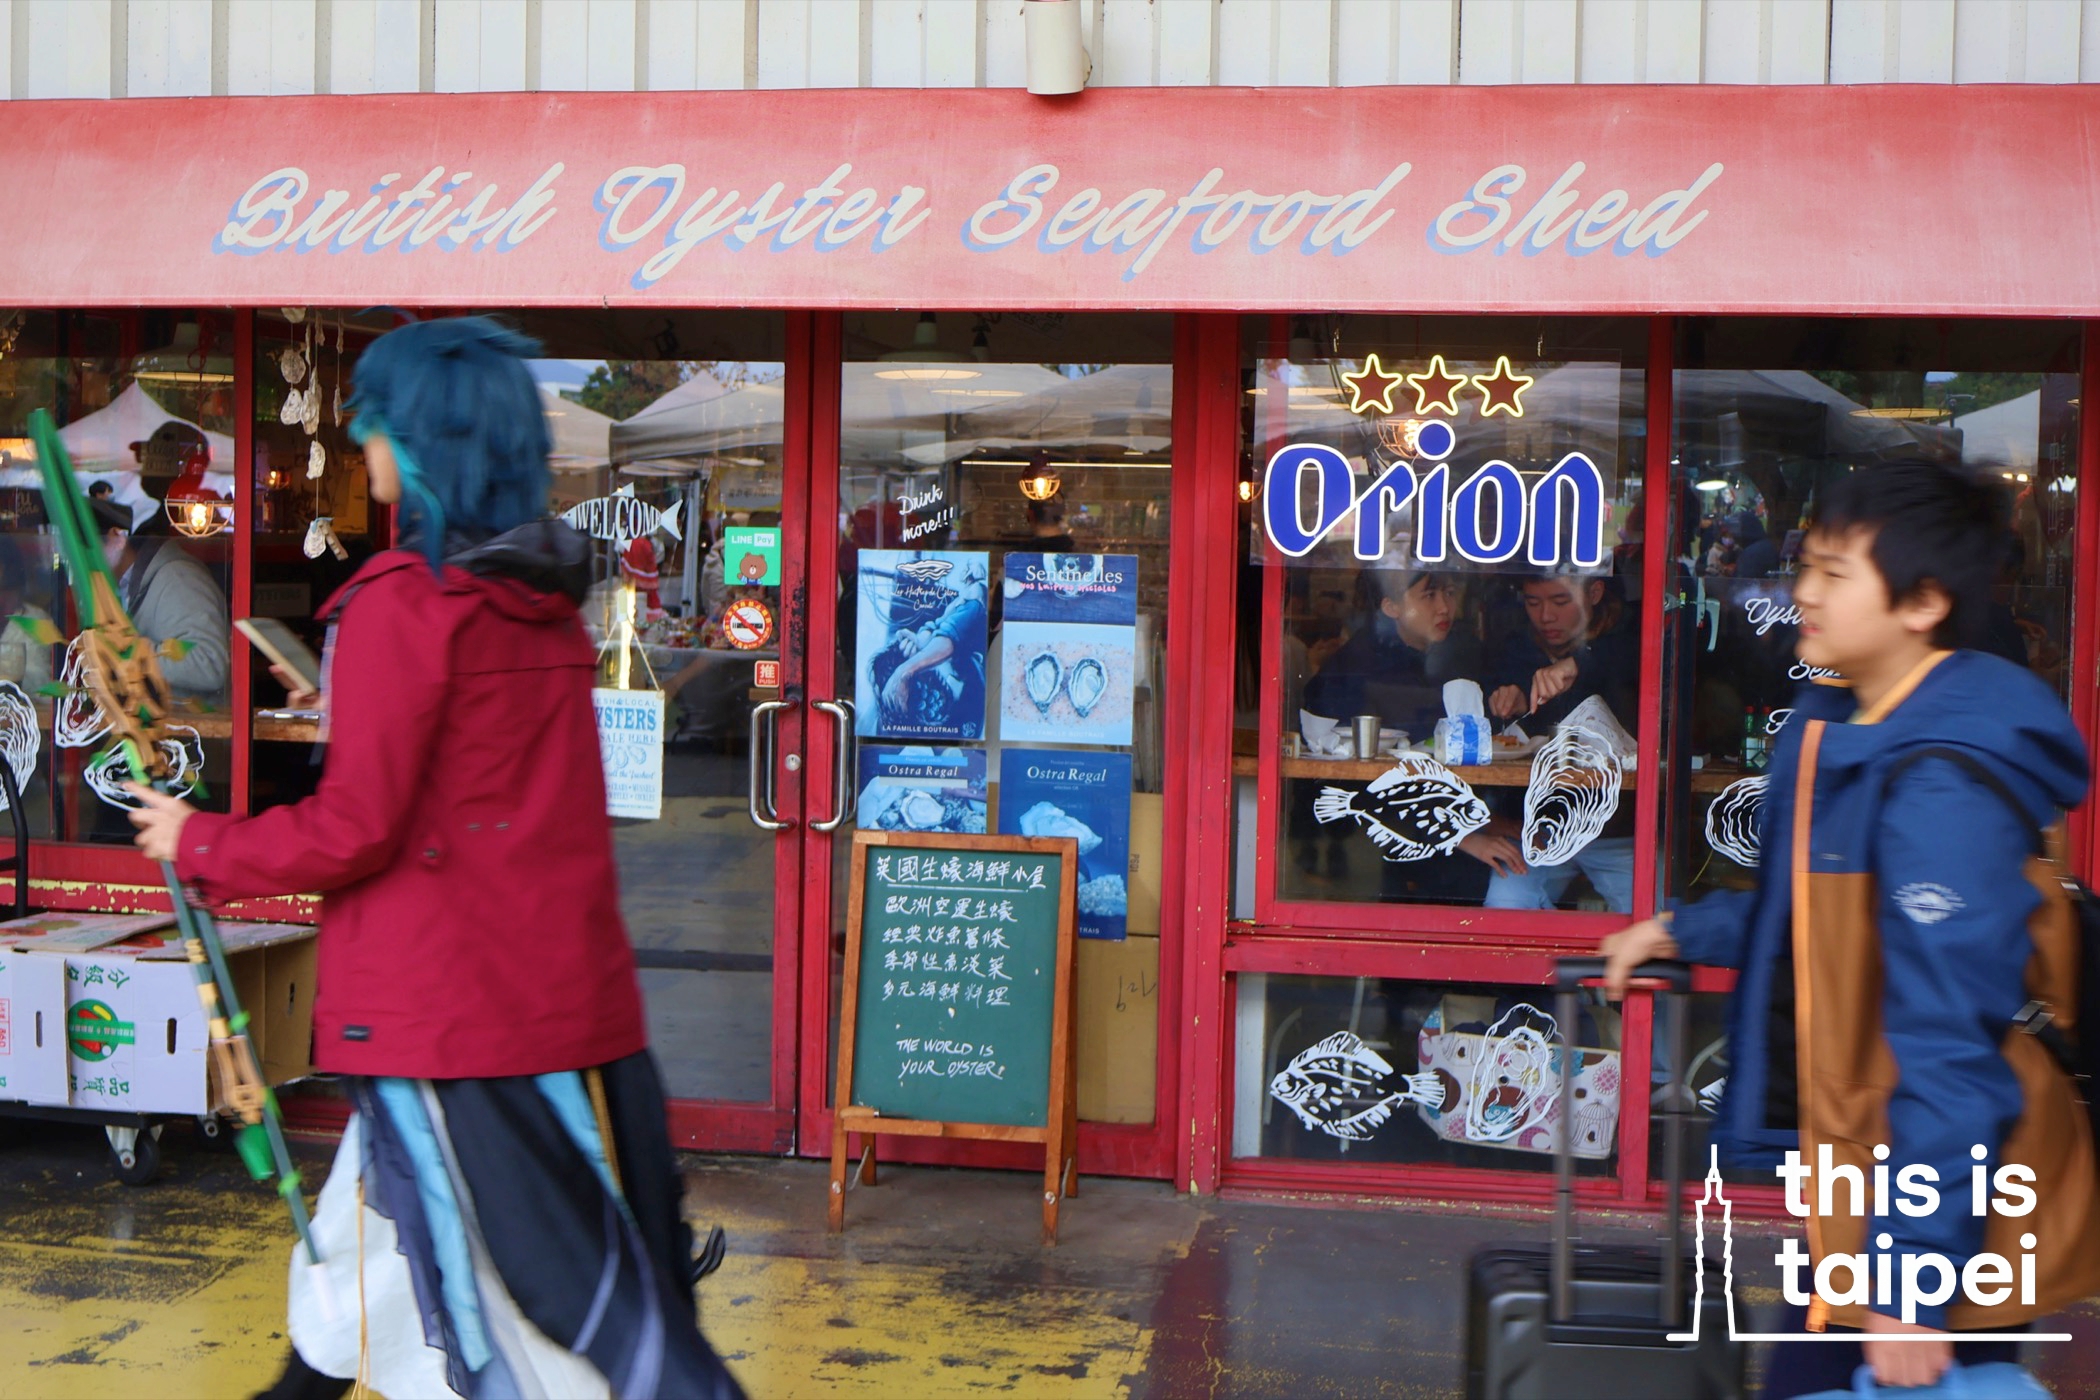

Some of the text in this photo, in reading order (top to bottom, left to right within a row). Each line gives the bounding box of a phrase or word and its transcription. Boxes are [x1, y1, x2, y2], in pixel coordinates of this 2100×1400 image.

[215, 160, 1724, 288] British Oyster Seafood Shed
[897, 484, 943, 515] Drink
[1263, 419, 1605, 567] Orion
[576, 497, 662, 540] WELCOME
[731, 535, 752, 544] LINE
[1026, 565, 1123, 584] Sentinelles
[760, 664, 775, 678] 推
[592, 697, 614, 705] ESH
[625, 698, 657, 707] LOCAL
[592, 706, 657, 731] YSTERS
[893, 725, 921, 733] FAMILLE
[923, 726, 959, 734] BOUTRAIS
[888, 765, 958, 778] Ostra Regal
[1027, 766, 1107, 784] Ostra Regal
[876, 855, 1046, 889] 英國生蠔海鮮小屋
[885, 895, 1018, 922] 歐洲空運生蠔
[882, 924, 1011, 950] 經典炸魚薯條
[884, 949, 1013, 980] 季節性煮淡菜
[882, 979, 1011, 1008] 多元海鮮料理
[896, 1038, 994, 1056] THE WORLD IS
[898, 1059, 945, 1079] YOUR
